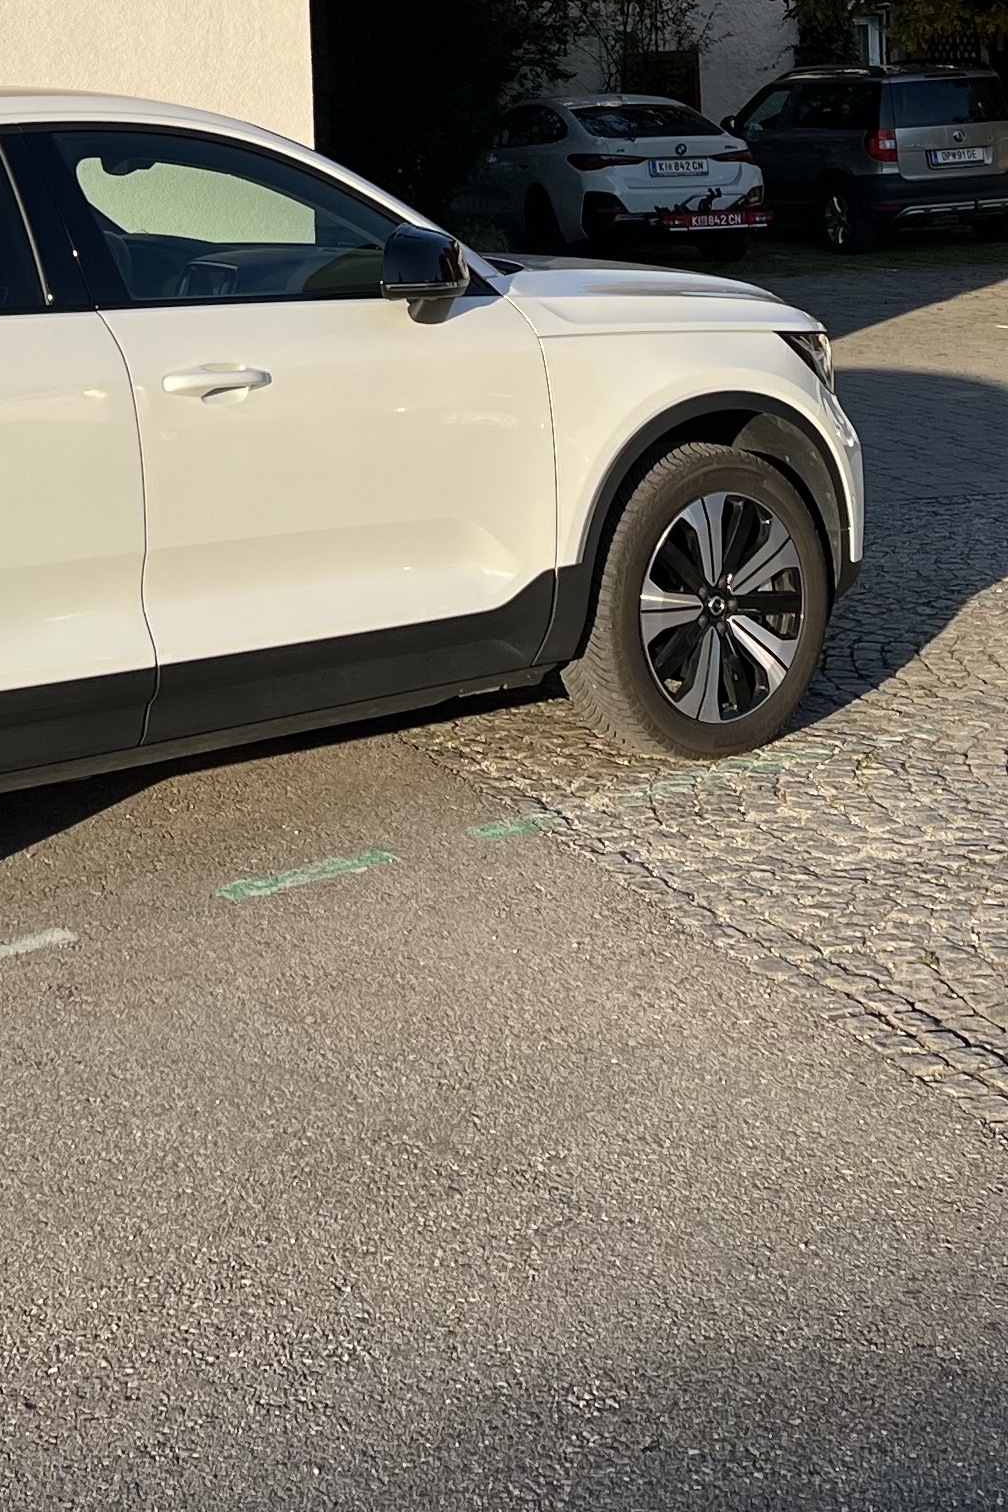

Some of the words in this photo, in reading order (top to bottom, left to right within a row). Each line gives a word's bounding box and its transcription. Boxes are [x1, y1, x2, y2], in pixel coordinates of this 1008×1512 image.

[674, 161, 690, 171] 842
[708, 215, 727, 225] 842
[728, 214, 741, 224] CN
